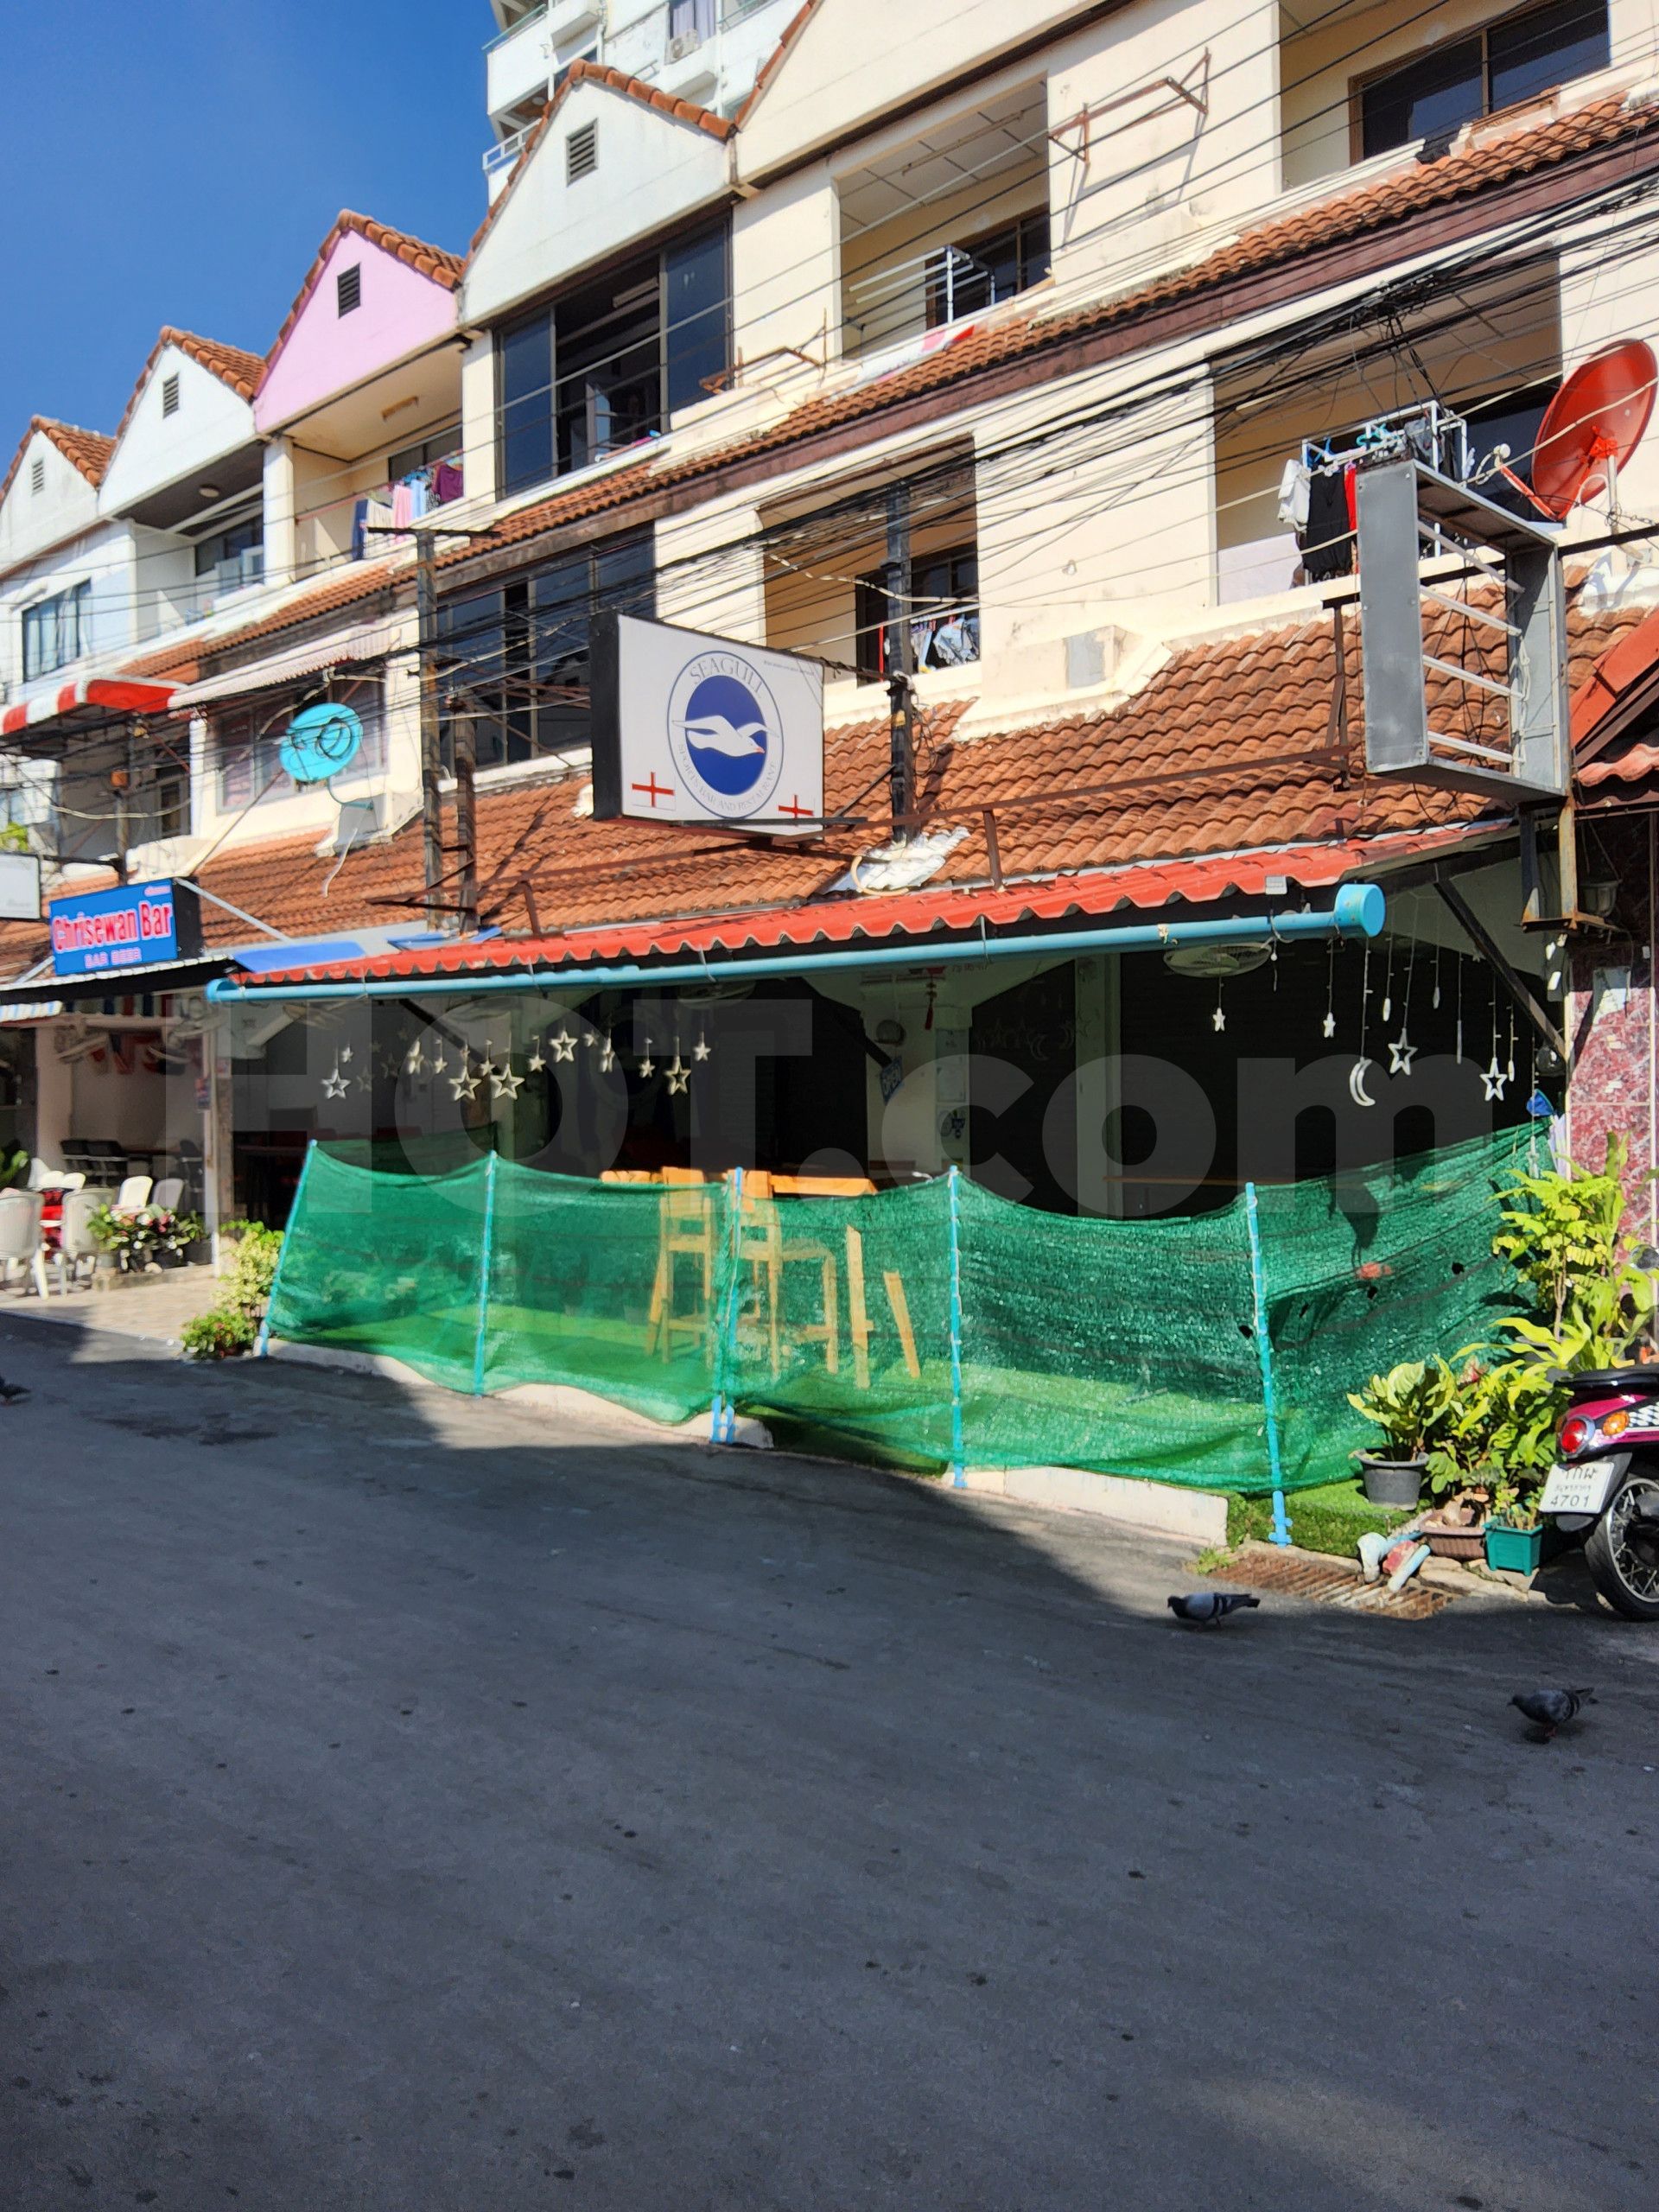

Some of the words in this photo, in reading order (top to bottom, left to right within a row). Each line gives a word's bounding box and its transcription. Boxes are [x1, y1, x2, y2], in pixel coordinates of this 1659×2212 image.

[690, 657, 763, 698] SEAGULL
[718, 799, 736, 811] AND
[52, 909, 139, 953] Chrisewan
[138, 900, 172, 940] Bar
[1550, 1494, 1590, 1507] 4701
